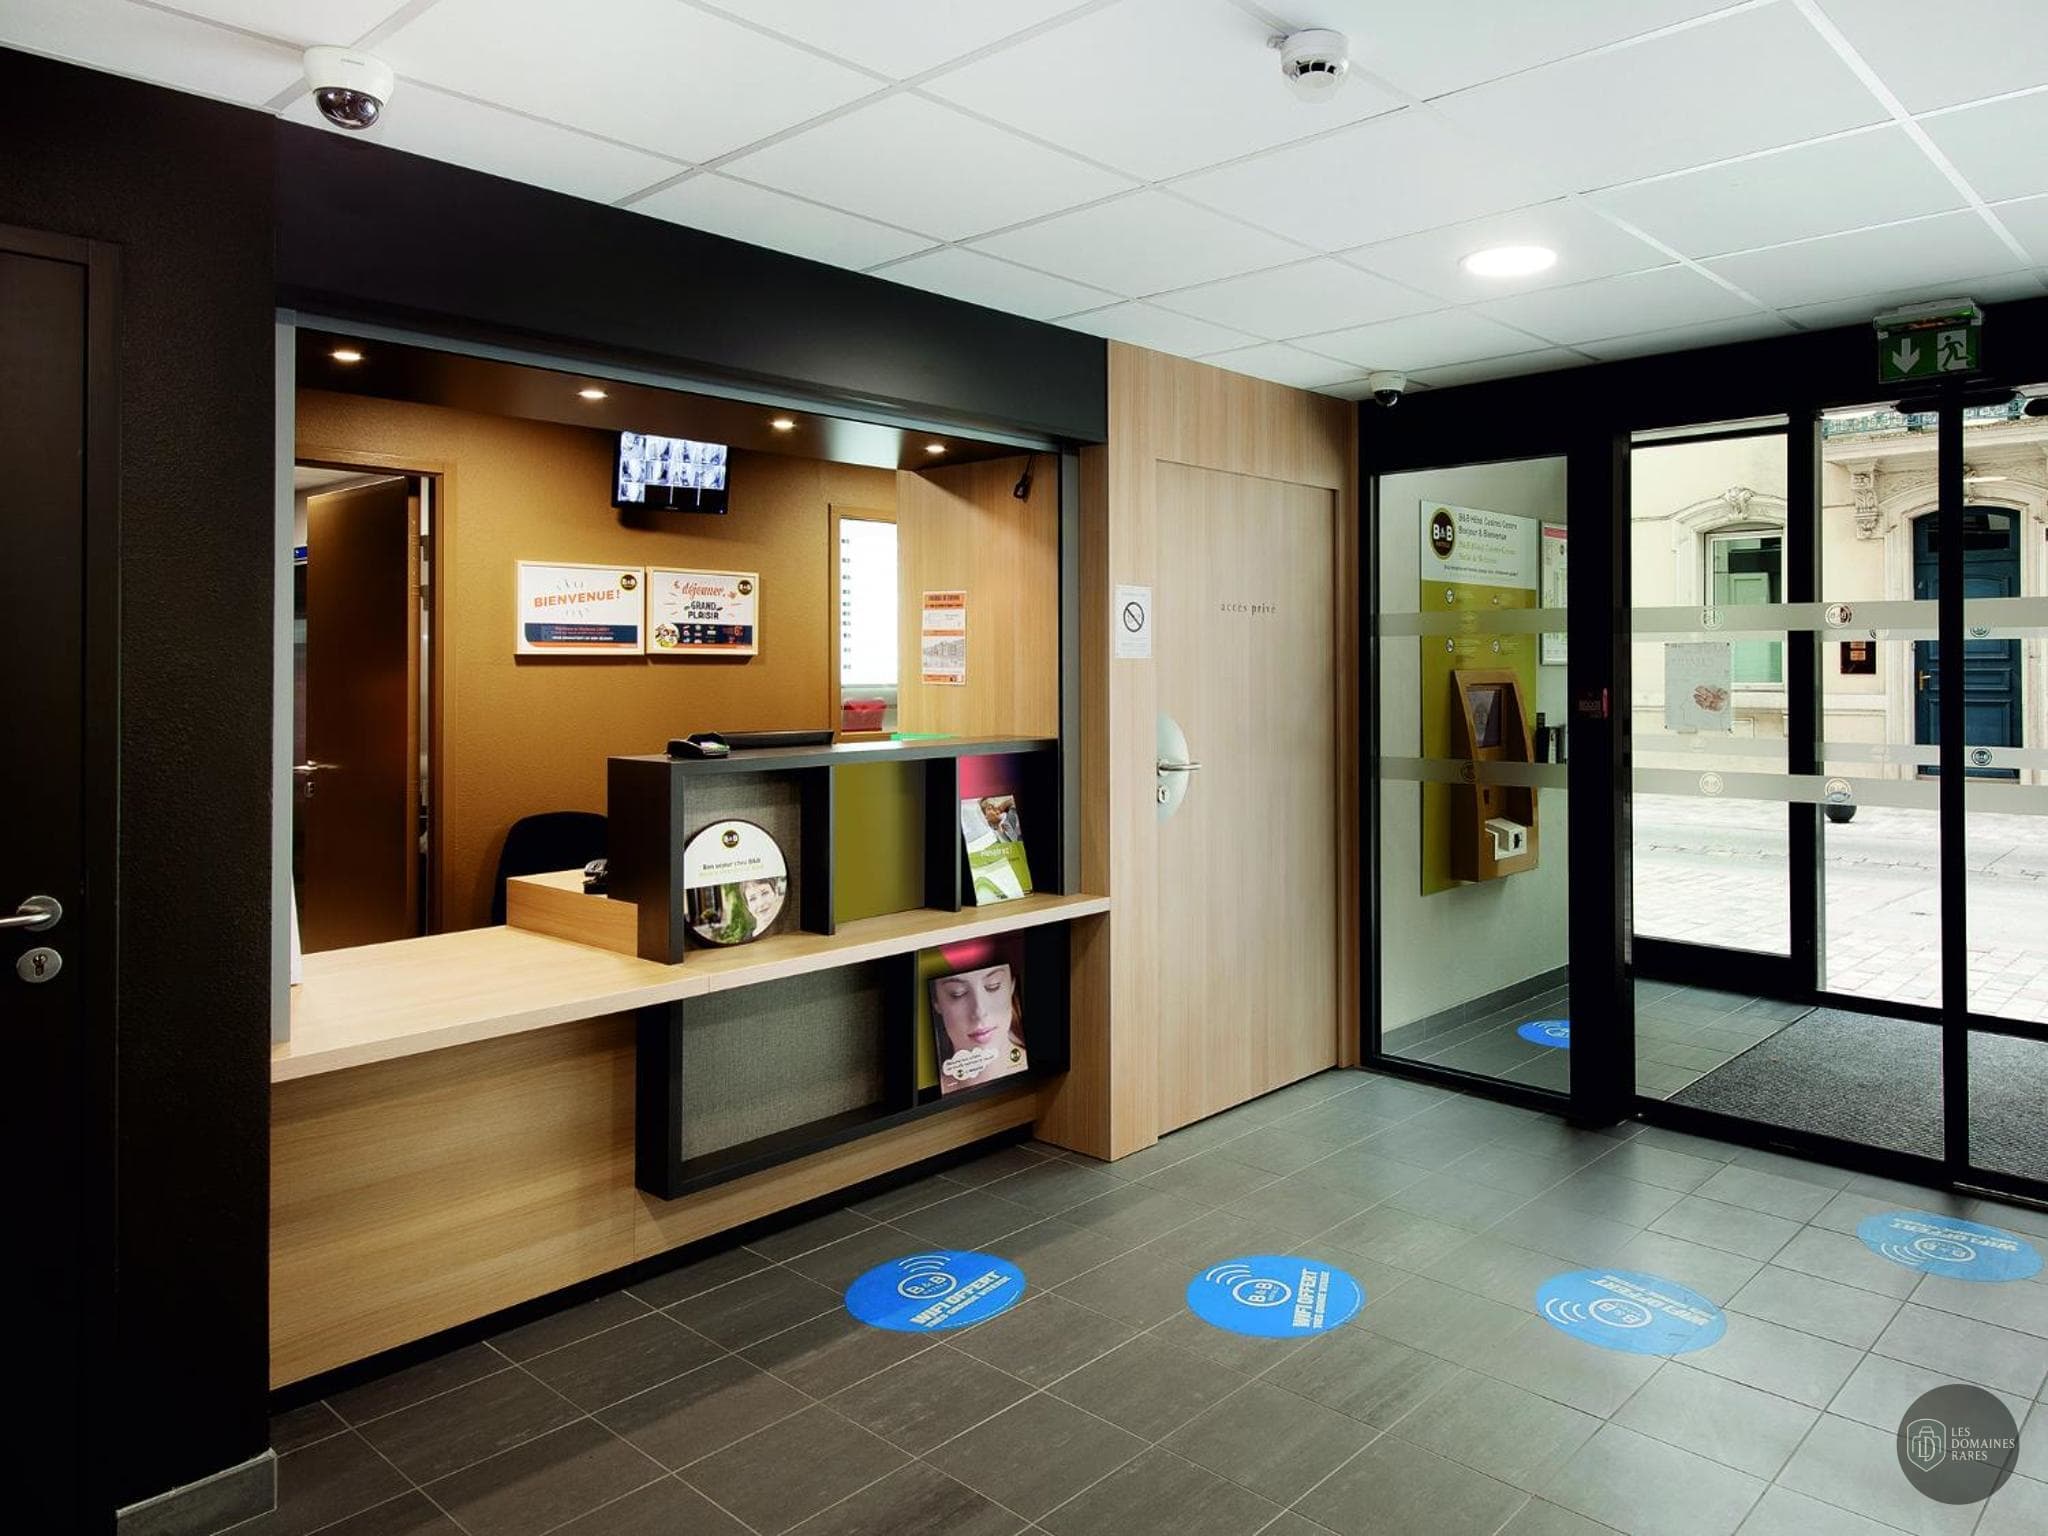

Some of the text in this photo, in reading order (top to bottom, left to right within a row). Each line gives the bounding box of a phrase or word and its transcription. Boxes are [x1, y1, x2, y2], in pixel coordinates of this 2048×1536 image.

[1433, 524, 1454, 541] B&B
[687, 611, 719, 620] PLAISIR
[690, 601, 717, 611] GRAND
[906, 1275, 947, 1295] B&B
[1248, 1282, 1273, 1303] B&B
[909, 1269, 1001, 1324] WIFI OFFERT
[1293, 1268, 1318, 1328] WIFI OFFERT
